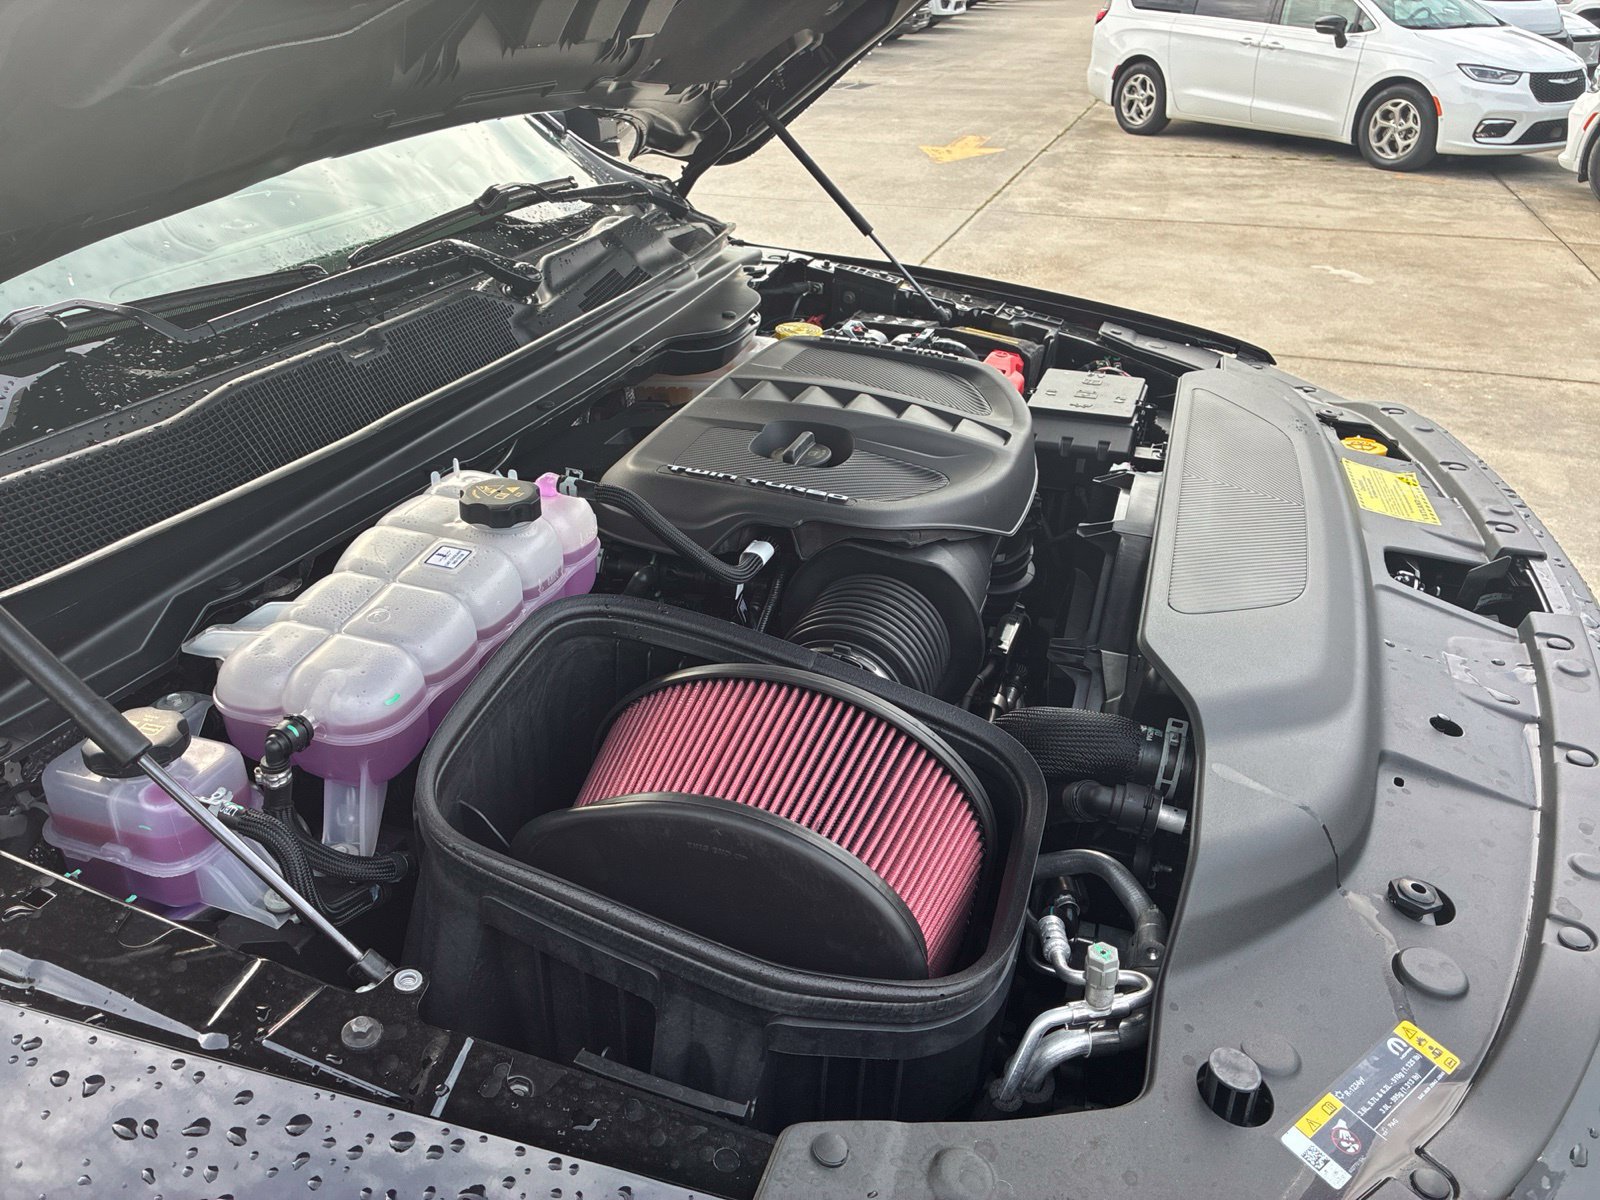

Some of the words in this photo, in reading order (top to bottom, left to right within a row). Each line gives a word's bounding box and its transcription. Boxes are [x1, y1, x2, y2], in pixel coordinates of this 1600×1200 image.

[667, 464, 738, 482] TWIN
[747, 478, 849, 503] TURBO
[1388, 1118, 1399, 1129] PAG
